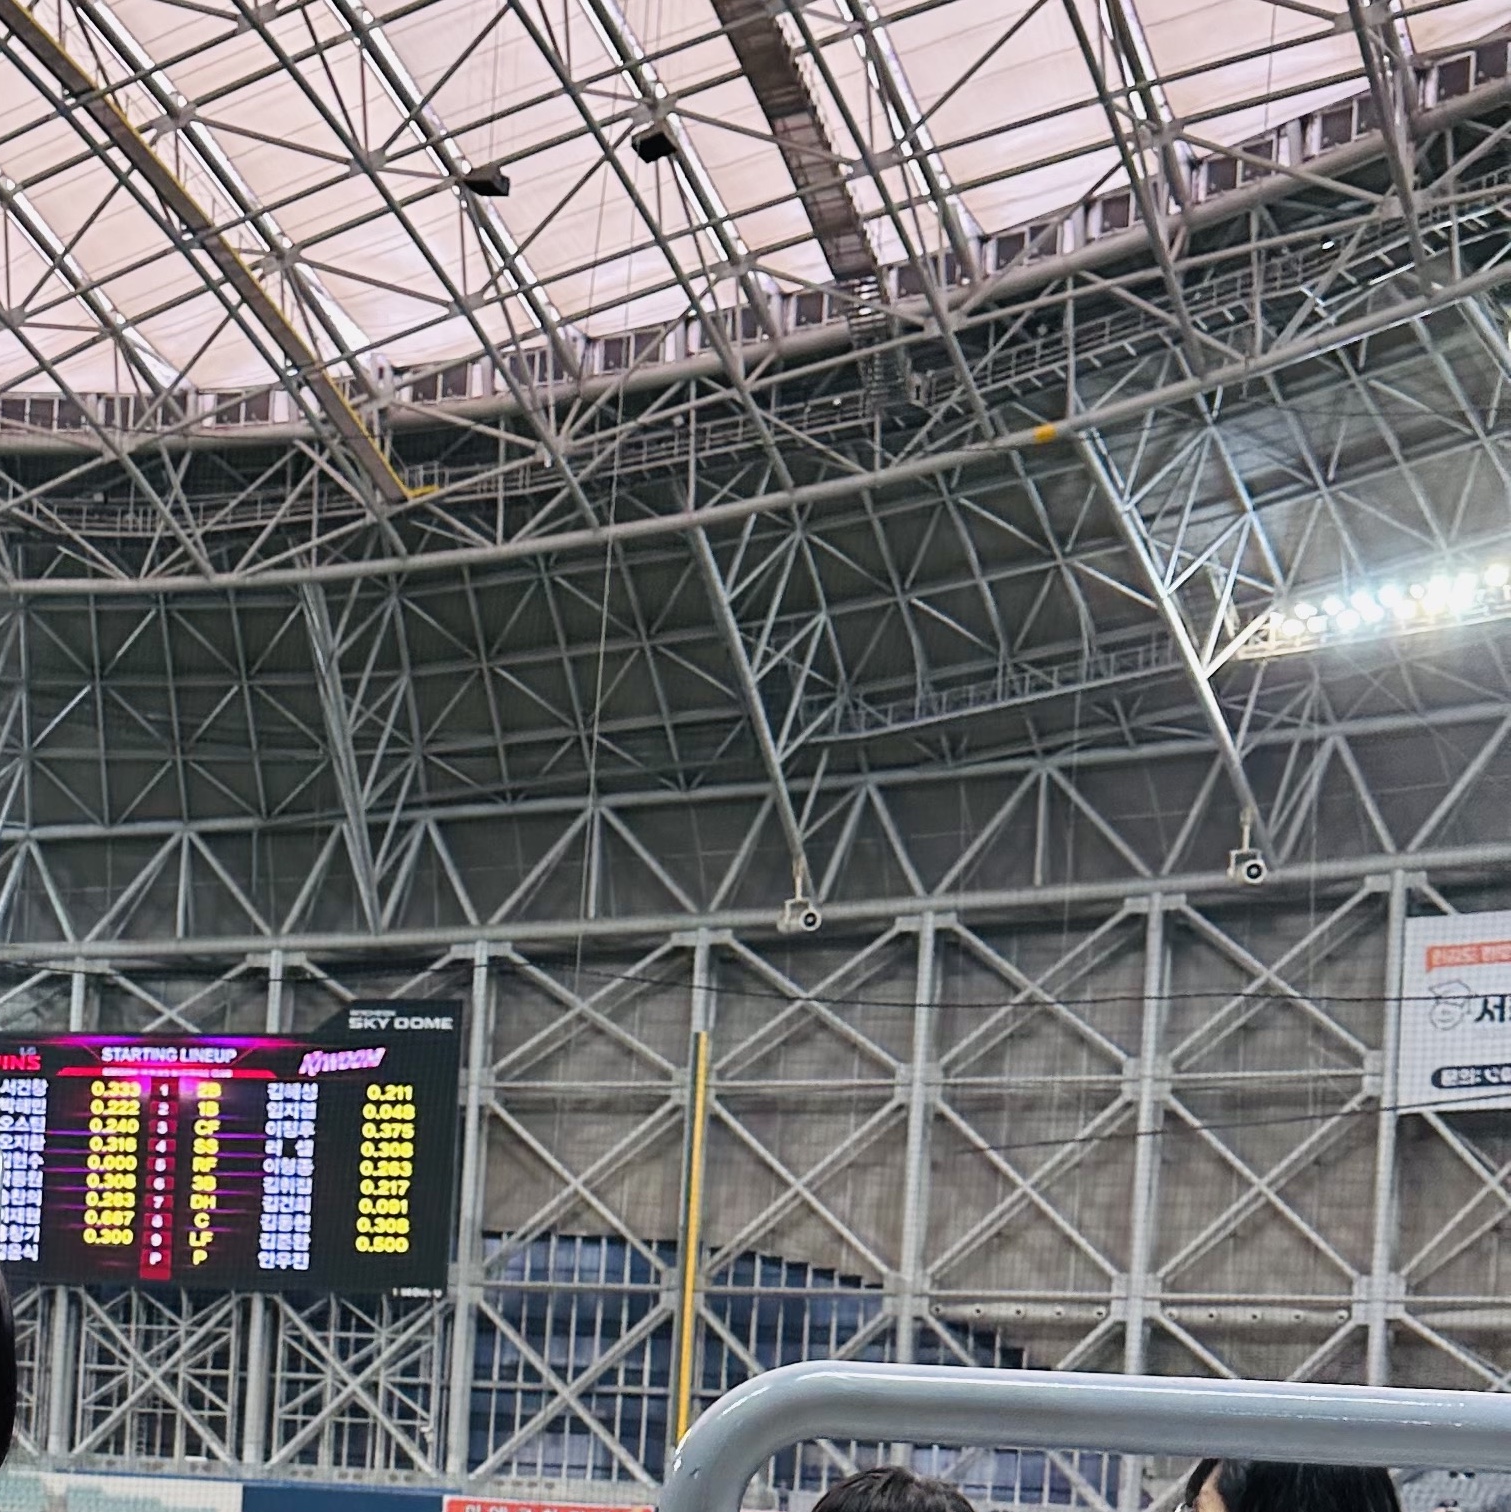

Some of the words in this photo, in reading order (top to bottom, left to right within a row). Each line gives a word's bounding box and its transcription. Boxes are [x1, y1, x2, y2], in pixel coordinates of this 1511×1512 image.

[348, 1017, 391, 1030] SKY
[393, 1016, 454, 1030] DOME
[101, 1046, 178, 1063] STARTING
[179, 1047, 238, 1064] LINEUP
[90, 1081, 142, 1097] 0.333
[159, 1084, 169, 1097] 1
[366, 1085, 413, 1102] 0.211
[90, 1099, 141, 1116] 0.222
[157, 1102, 170, 1116] 2
[89, 1118, 140, 1134] 0.240
[194, 1120, 221, 1136] CF
[361, 1123, 415, 1139] 0.375
[155, 1139, 167, 1153] 4
[87, 1155, 138, 1171] 0.000
[192, 1157, 218, 1173] RF
[359, 1179, 411, 1196] 0.217
[153, 1196, 165, 1209] 7
[190, 1194, 217, 1210] DH
[193, 1212, 210, 1229] C
[84, 1228, 134, 1245] 0.300
[188, 1231, 214, 1247] LF
[149, 1252, 162, 1265] P
[192, 1250, 208, 1266] P
